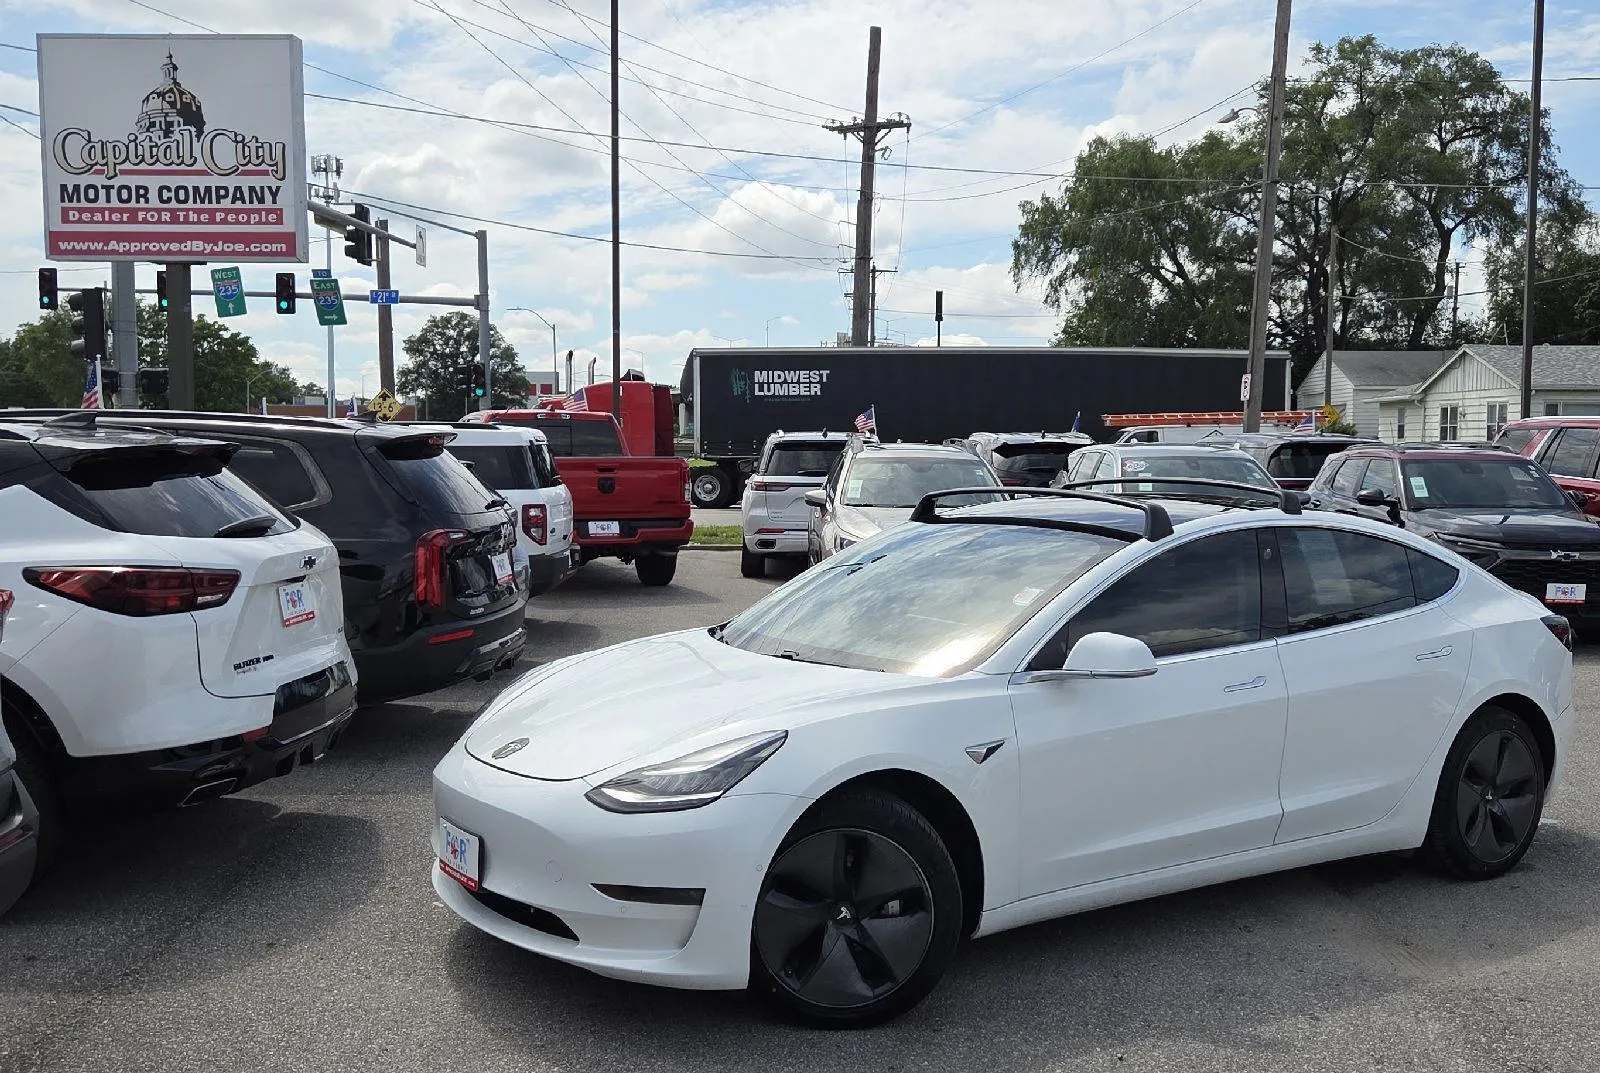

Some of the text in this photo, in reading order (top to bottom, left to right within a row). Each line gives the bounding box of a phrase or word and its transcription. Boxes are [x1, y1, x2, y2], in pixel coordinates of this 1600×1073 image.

[53, 128, 286, 181] Capital City
[59, 183, 282, 205] MOTOR COMPANY
[68, 210, 278, 224] Dealer FOR The People
[58, 239, 287, 254] www.ApprovedByJoe.com
[213, 270, 238, 280] WEST
[219, 284, 239, 296] 235
[313, 281, 336, 290] EAST
[319, 295, 338, 305] 235
[754, 370, 830, 383] MIDWEST
[754, 383, 821, 396] LUMBER
